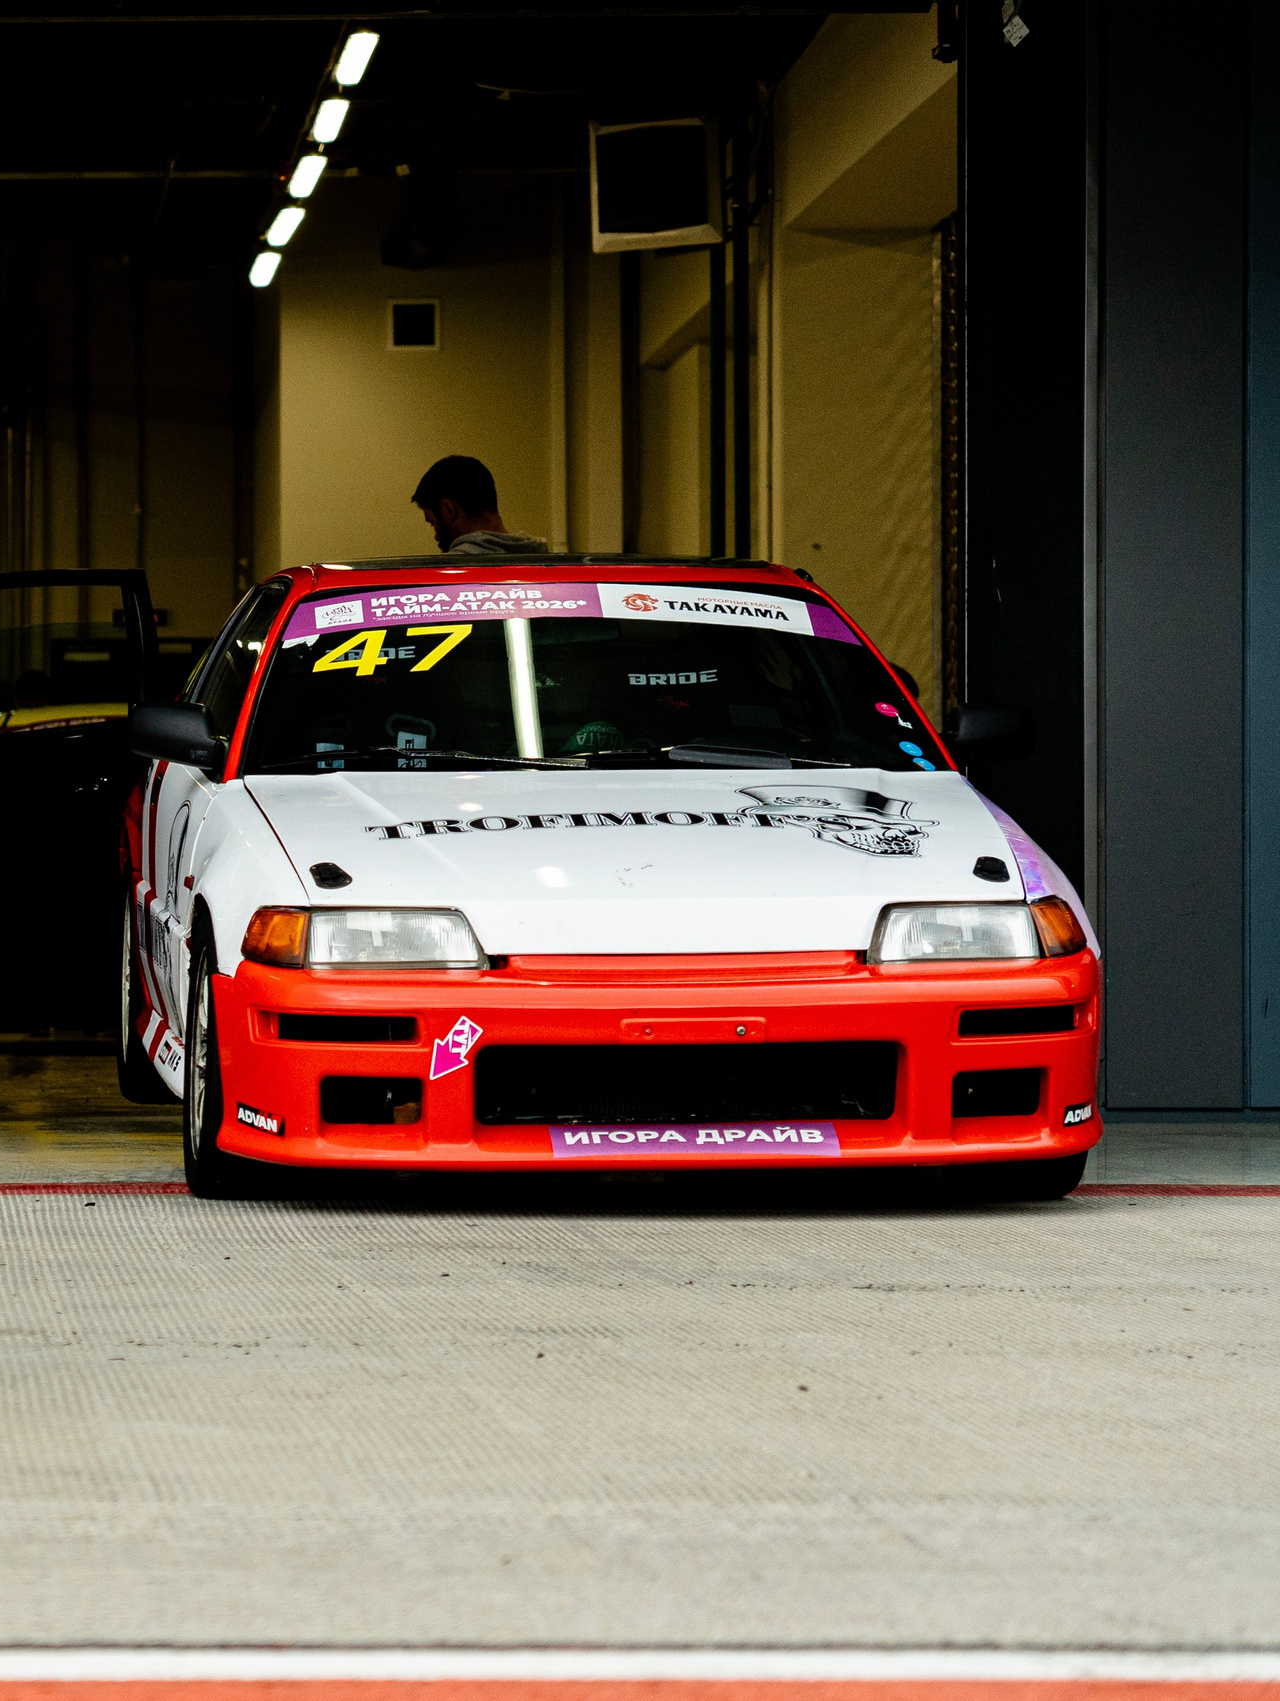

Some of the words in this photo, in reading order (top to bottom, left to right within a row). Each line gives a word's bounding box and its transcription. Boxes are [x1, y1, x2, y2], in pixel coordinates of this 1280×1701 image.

[370, 592, 451, 608] ИГОРА
[457, 588, 543, 602] ДРАЙВ
[697, 597, 748, 606] МОТОРНЫЕ
[751, 602, 782, 610] МАСЛА
[370, 600, 517, 618] ТАЙМ-АТАК
[664, 600, 790, 621] TAKAYAMA
[312, 624, 473, 676] 47
[627, 669, 718, 686] BRIDE
[237, 1107, 278, 1133] ADVAN
[564, 1131, 686, 1145] ИГОРА
[695, 1126, 824, 1145] ДРАЙВ
